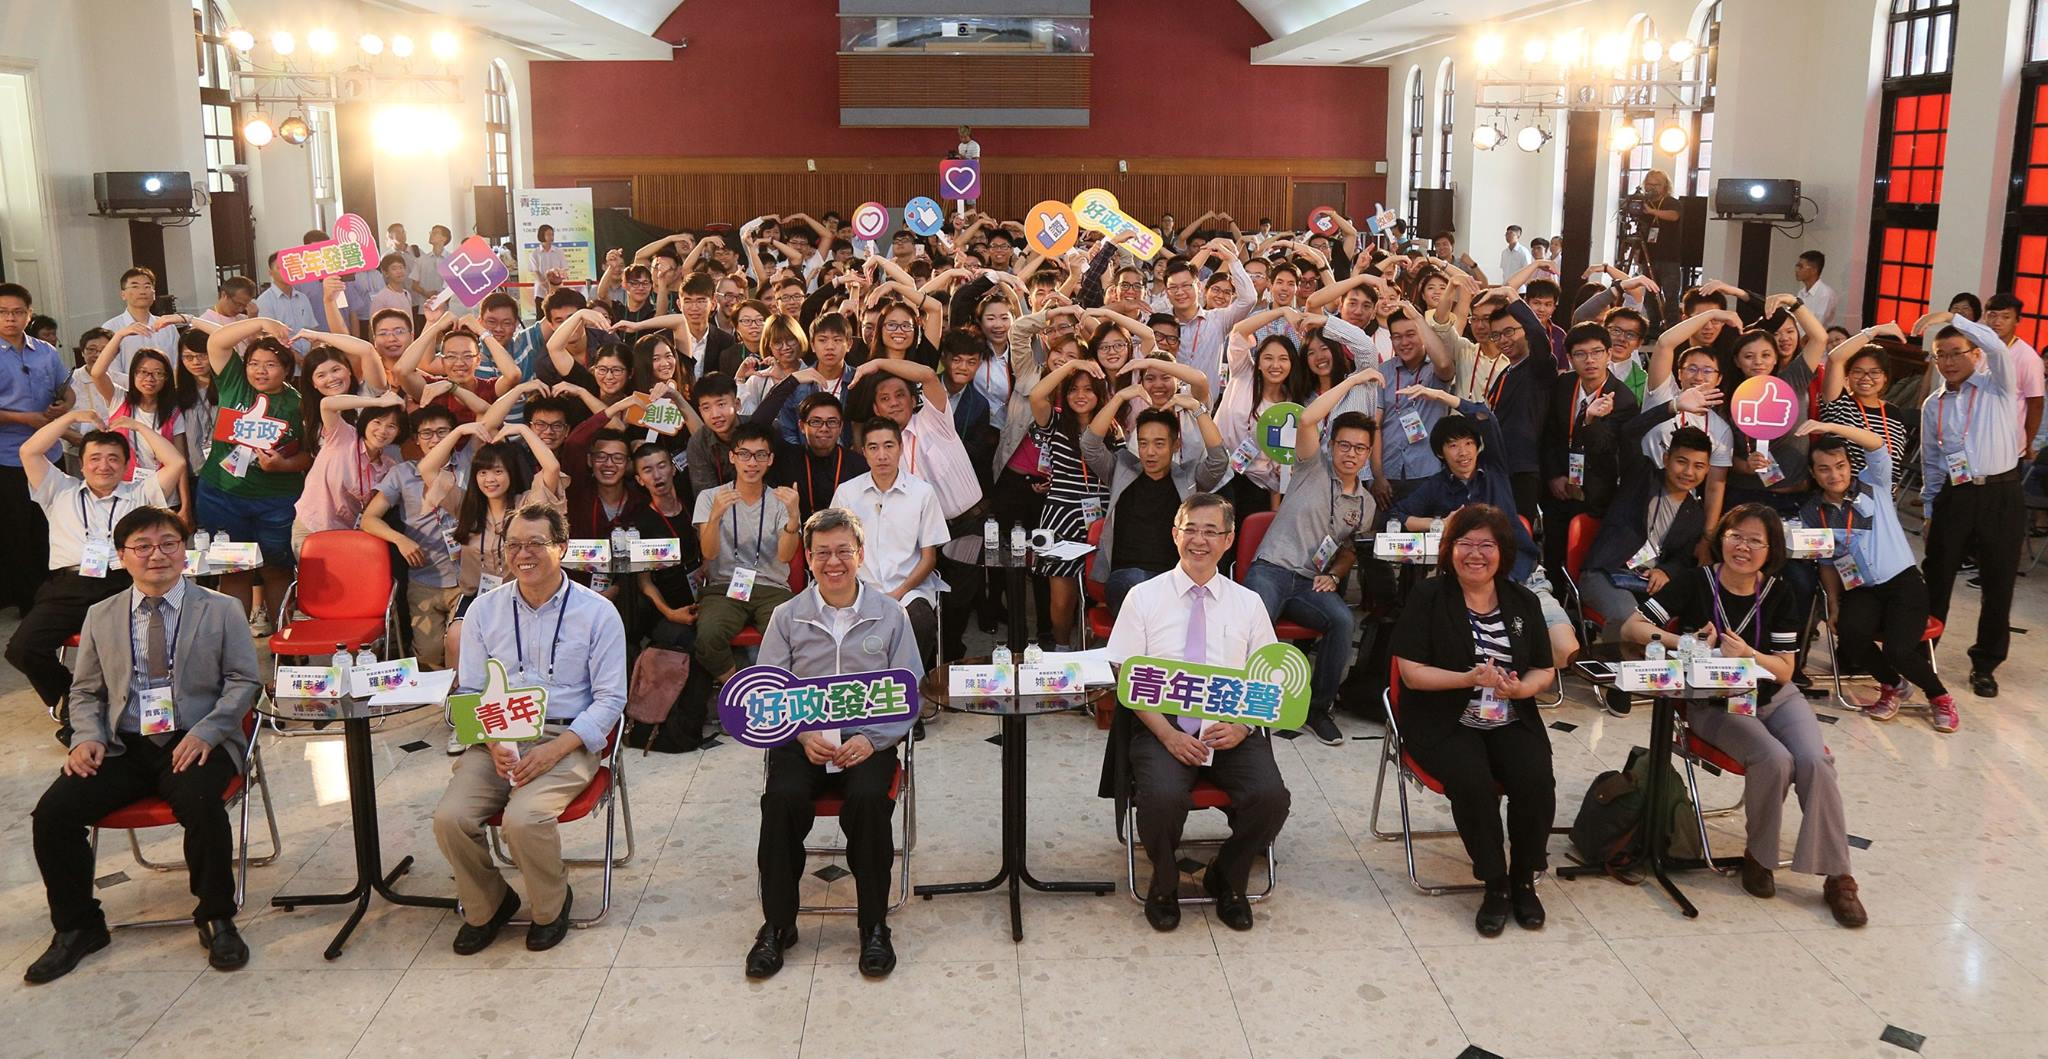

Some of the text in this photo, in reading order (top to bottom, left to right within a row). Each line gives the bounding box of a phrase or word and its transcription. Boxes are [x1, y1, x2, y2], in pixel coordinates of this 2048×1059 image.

[283, 242, 365, 280] 青年發聲
[235, 420, 279, 440] 好政
[644, 404, 683, 425] 創新
[746, 679, 909, 728] 好政發生
[1129, 666, 1282, 721] 青年發聲
[475, 695, 540, 734] 青年
